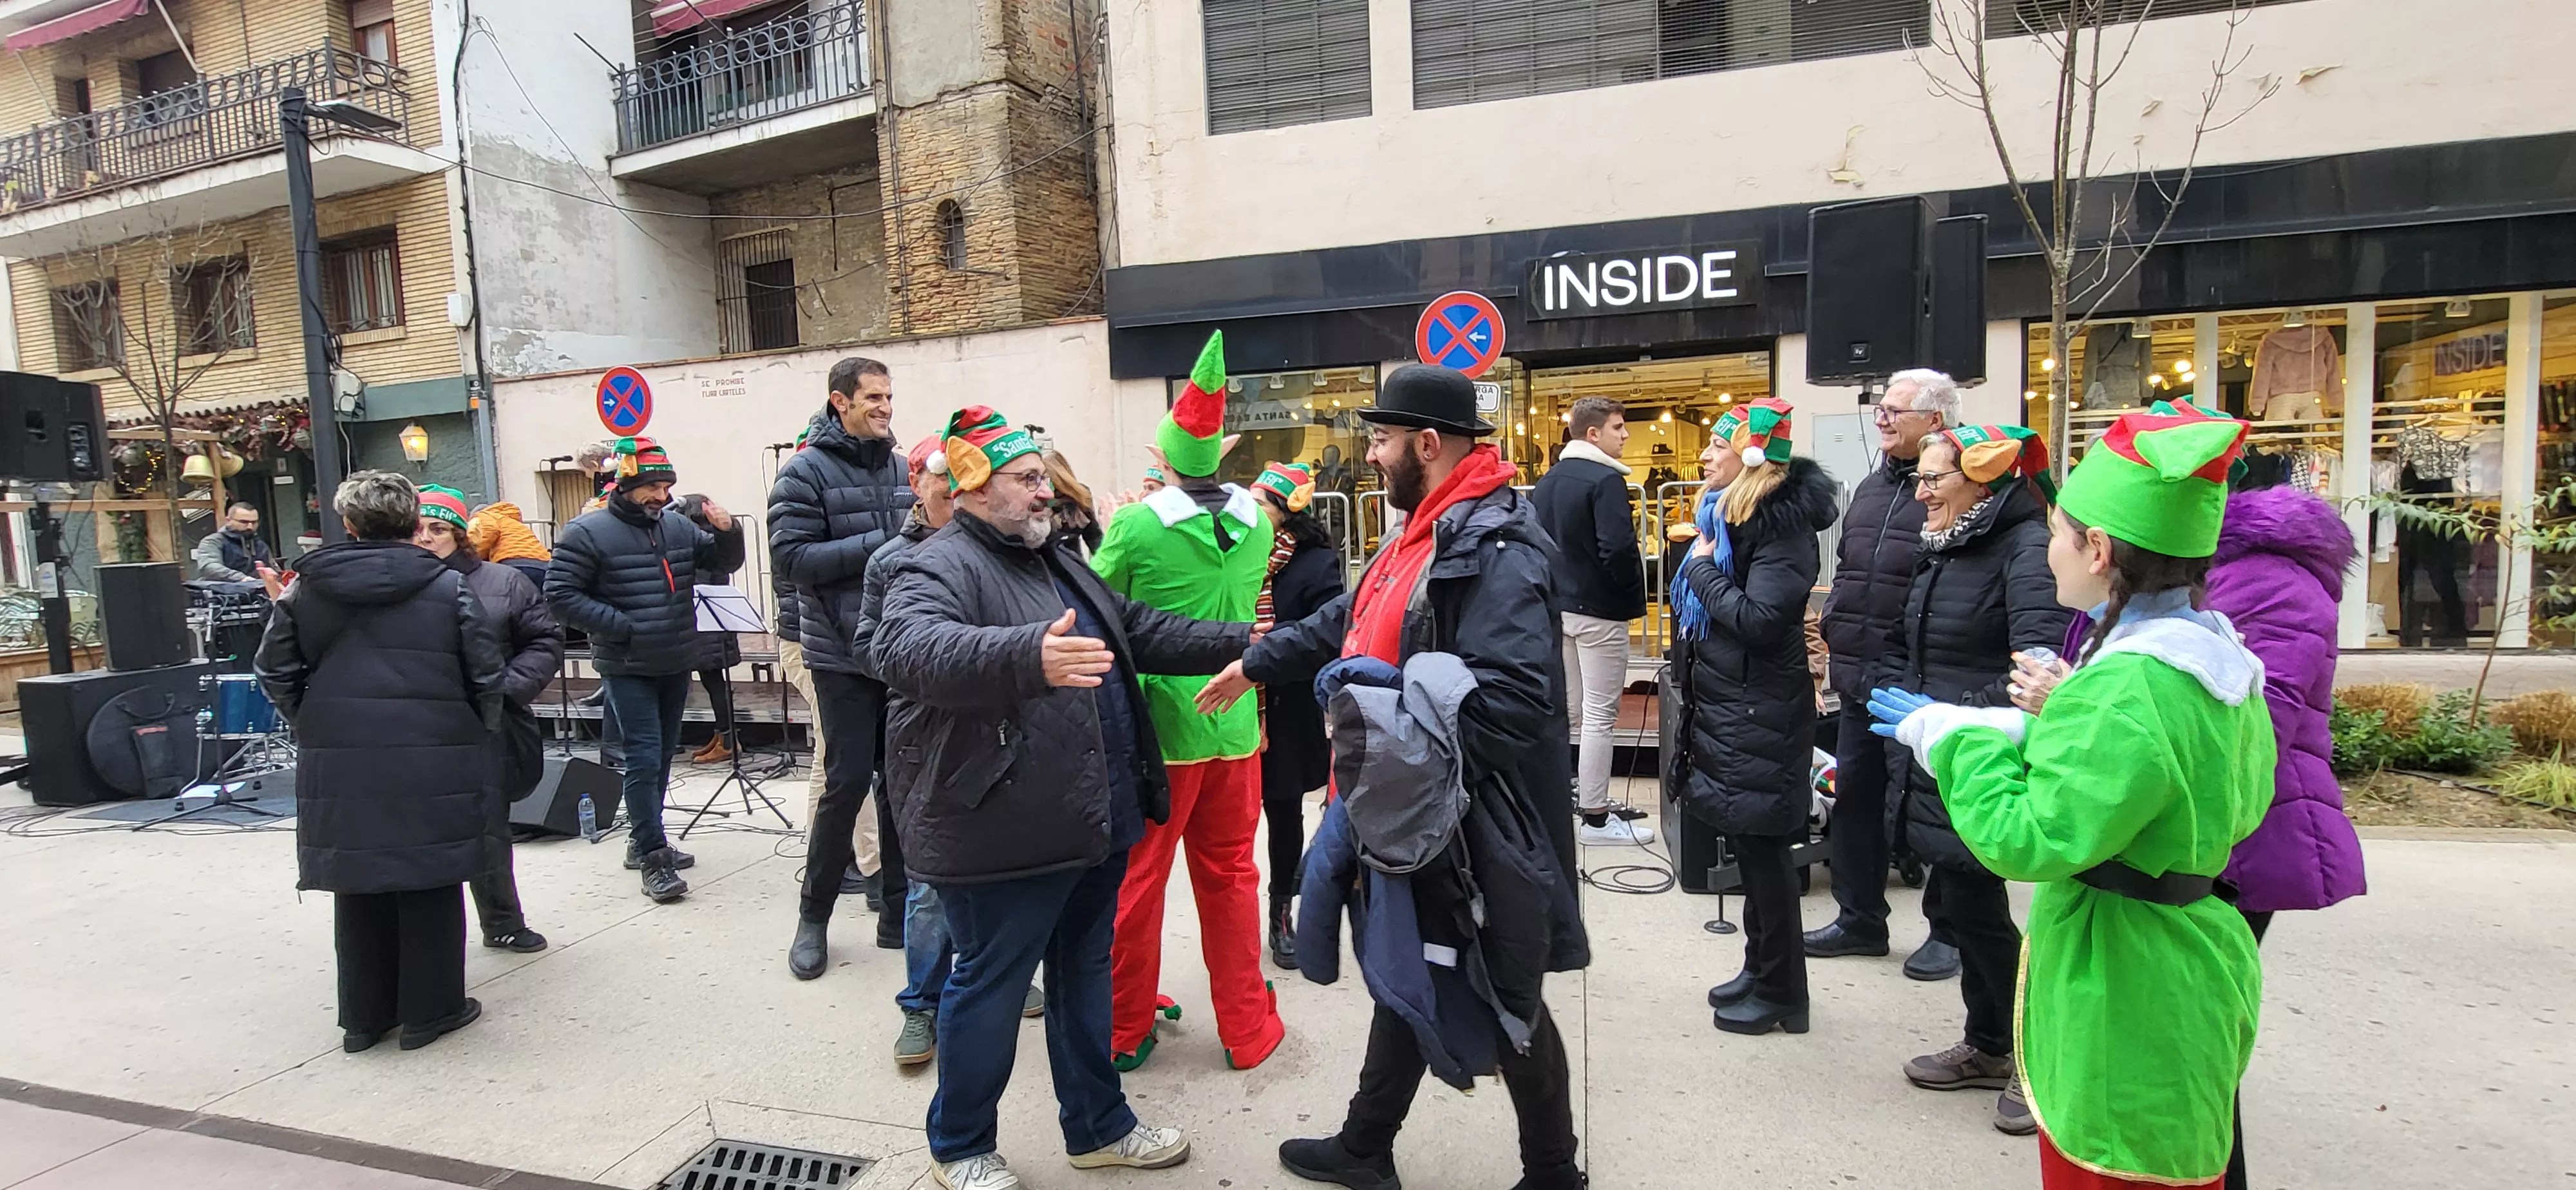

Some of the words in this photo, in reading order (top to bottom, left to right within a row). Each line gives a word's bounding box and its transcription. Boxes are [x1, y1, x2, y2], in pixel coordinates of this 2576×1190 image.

[1544, 250, 1738, 310] INSIDE
[715, 377, 745, 386] PROHIBE
[719, 388, 746, 396] CARTELES
